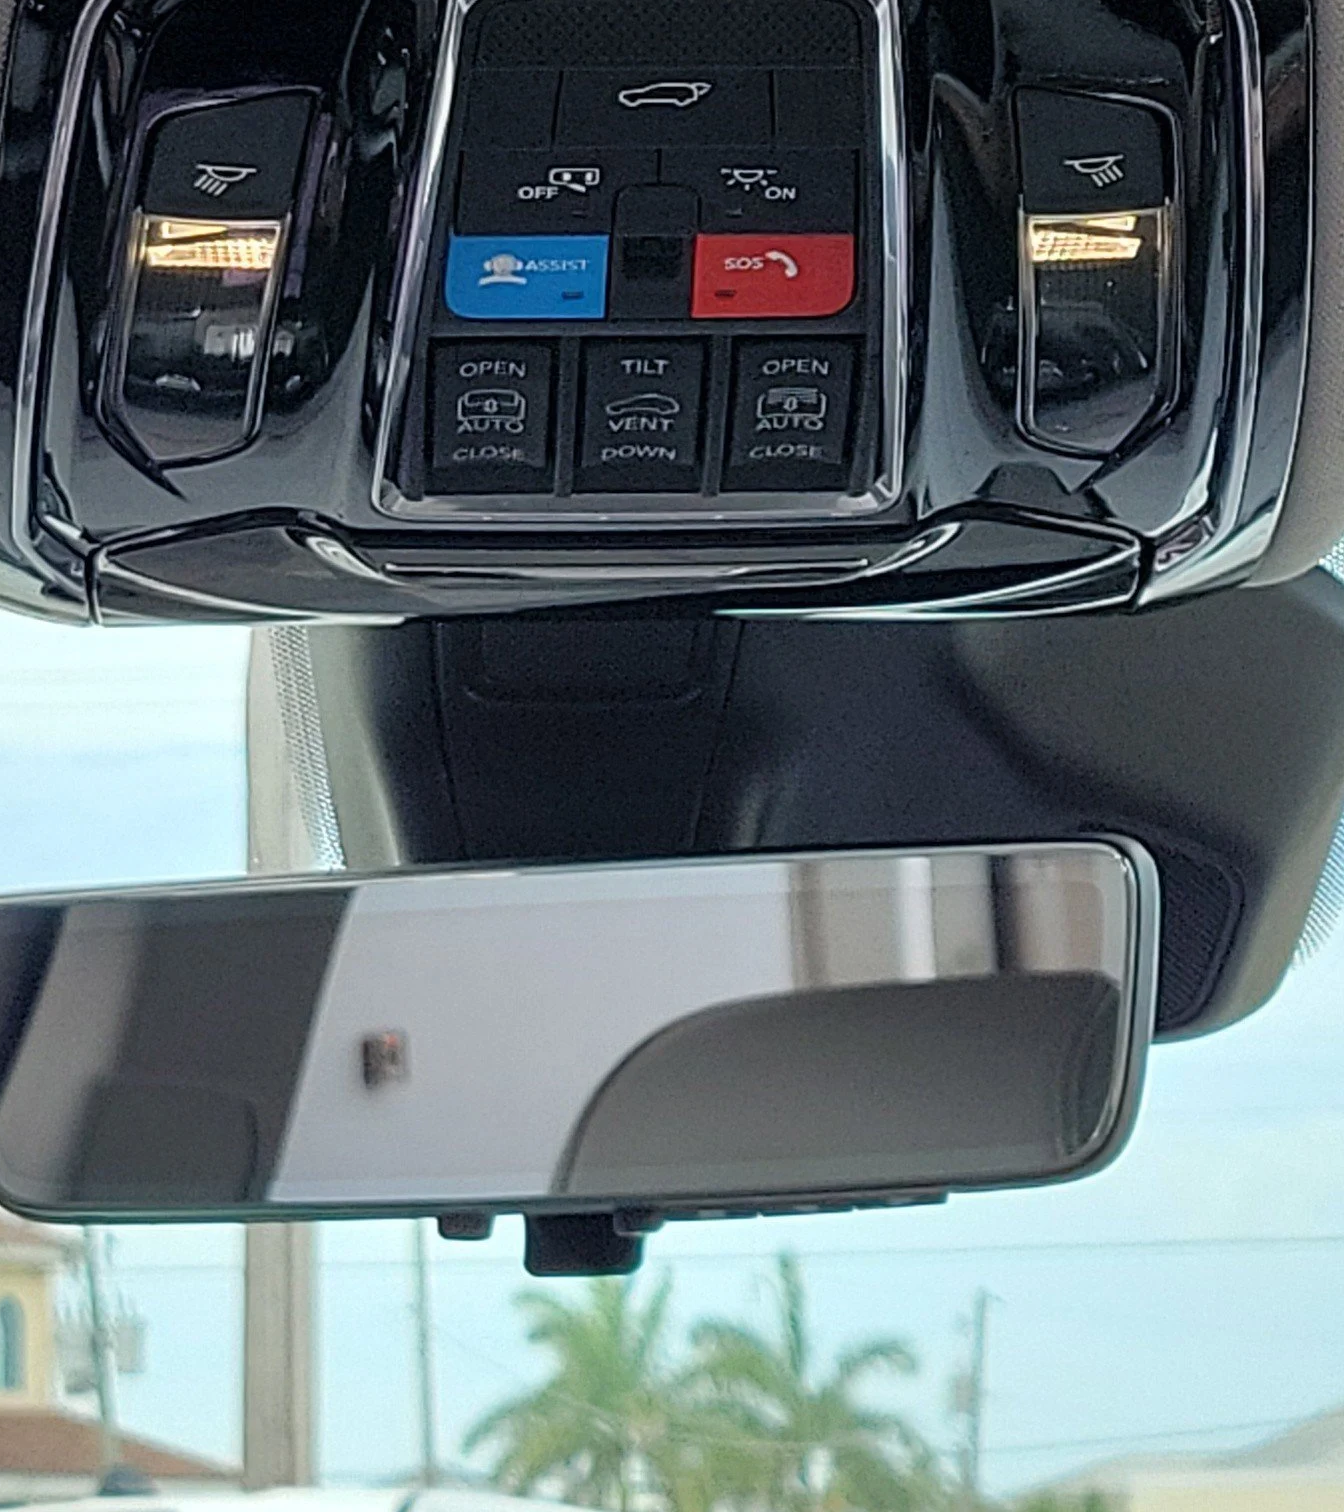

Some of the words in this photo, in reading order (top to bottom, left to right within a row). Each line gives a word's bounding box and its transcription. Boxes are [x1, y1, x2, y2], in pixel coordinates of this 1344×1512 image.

[518, 187, 558, 200] OFF
[765, 187, 796, 200] ON
[524, 259, 588, 272] ASSIST
[724, 257, 764, 270] SOS
[459, 361, 525, 378] OPEN
[620, 359, 669, 375] TILT
[762, 359, 829, 376] OPEN
[457, 419, 524, 434] AUTO
[608, 418, 674, 432] VENT
[755, 418, 823, 431] AUTO
[453, 445, 522, 461] CLOSE
[602, 445, 676, 461] DOWN
[749, 444, 824, 460] CLOSE
